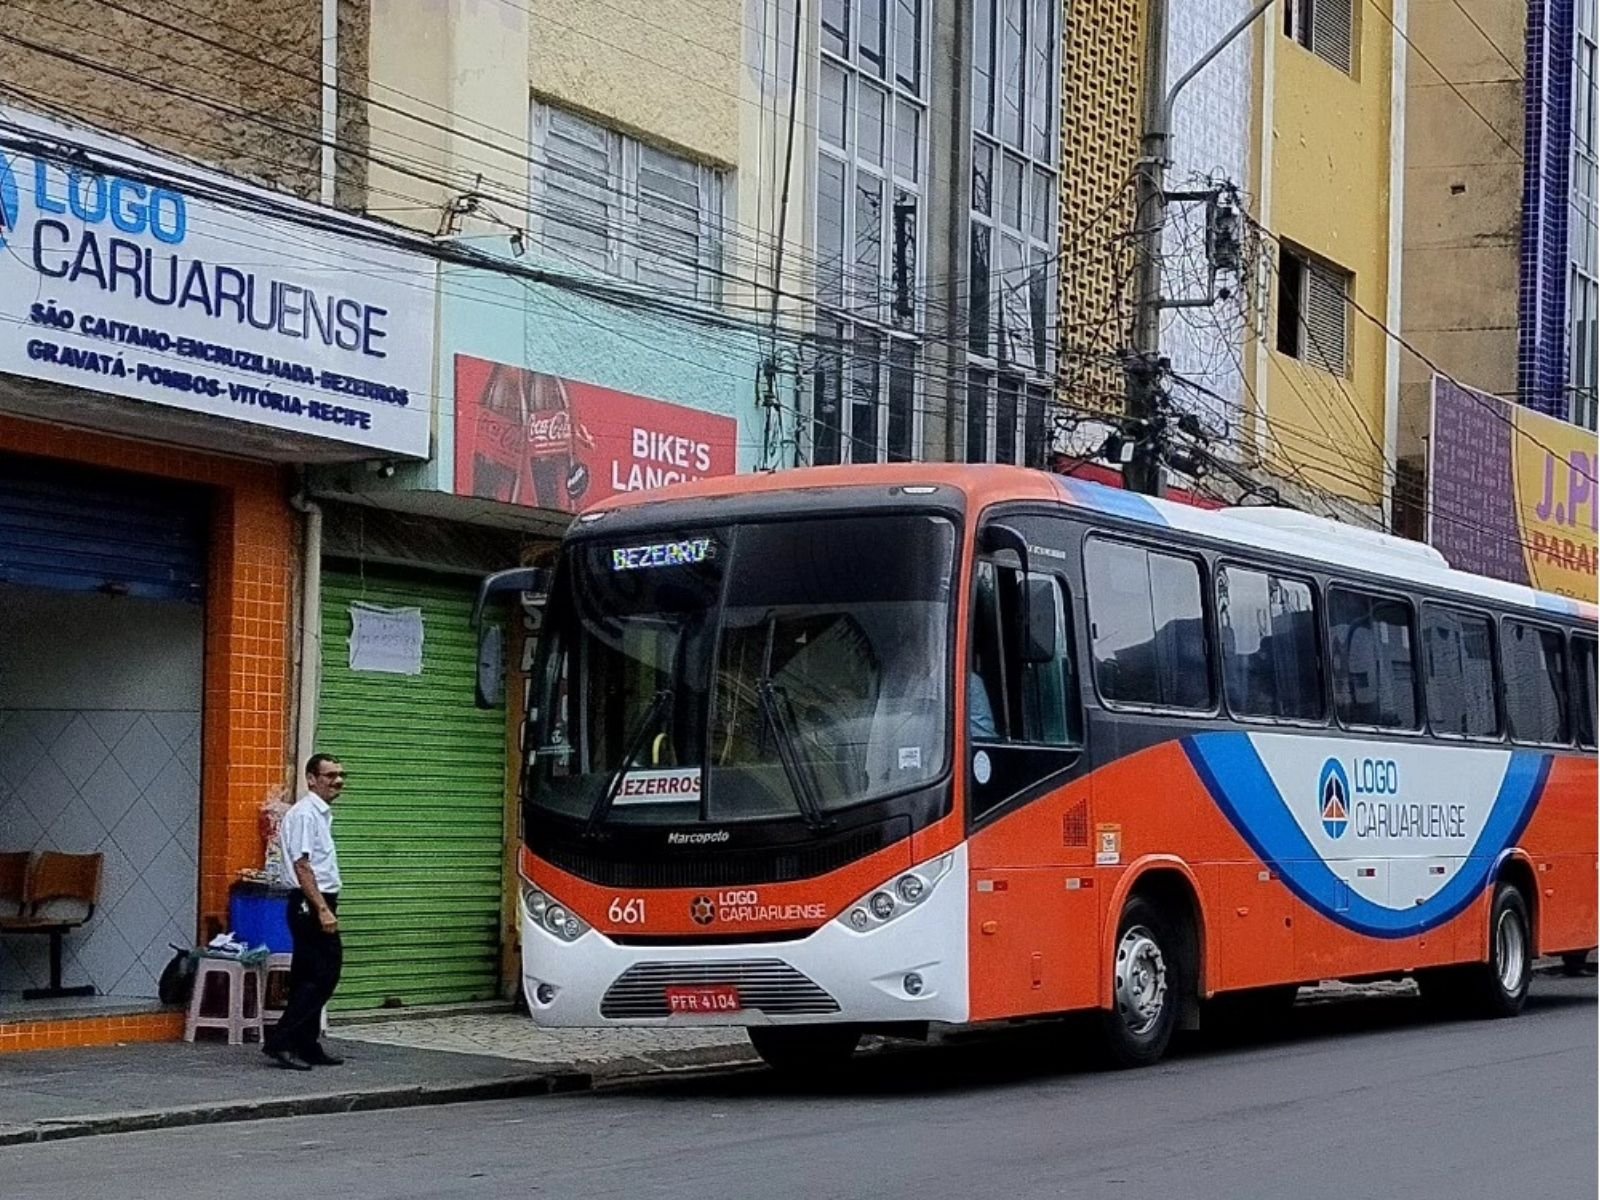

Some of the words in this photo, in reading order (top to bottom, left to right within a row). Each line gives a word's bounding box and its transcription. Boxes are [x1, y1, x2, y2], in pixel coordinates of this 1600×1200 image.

[35, 160, 187, 245] LOGO
[33, 218, 388, 358] CARUARUENSE
[30, 300, 74, 329] SÃO
[632, 427, 711, 472] BIKE'S
[611, 460, 705, 492] LANC
[616, 775, 701, 796] EZERROS
[1353, 758, 1398, 795] LOGO
[1355, 801, 1466, 838] CARUARUENSE
[667, 829, 730, 844] Marcopolo
[607, 897, 646, 924] 661
[718, 890, 758, 906] LOGO
[718, 903, 827, 922] CARUARUENSE
[701, 993, 738, 1010] 4104
